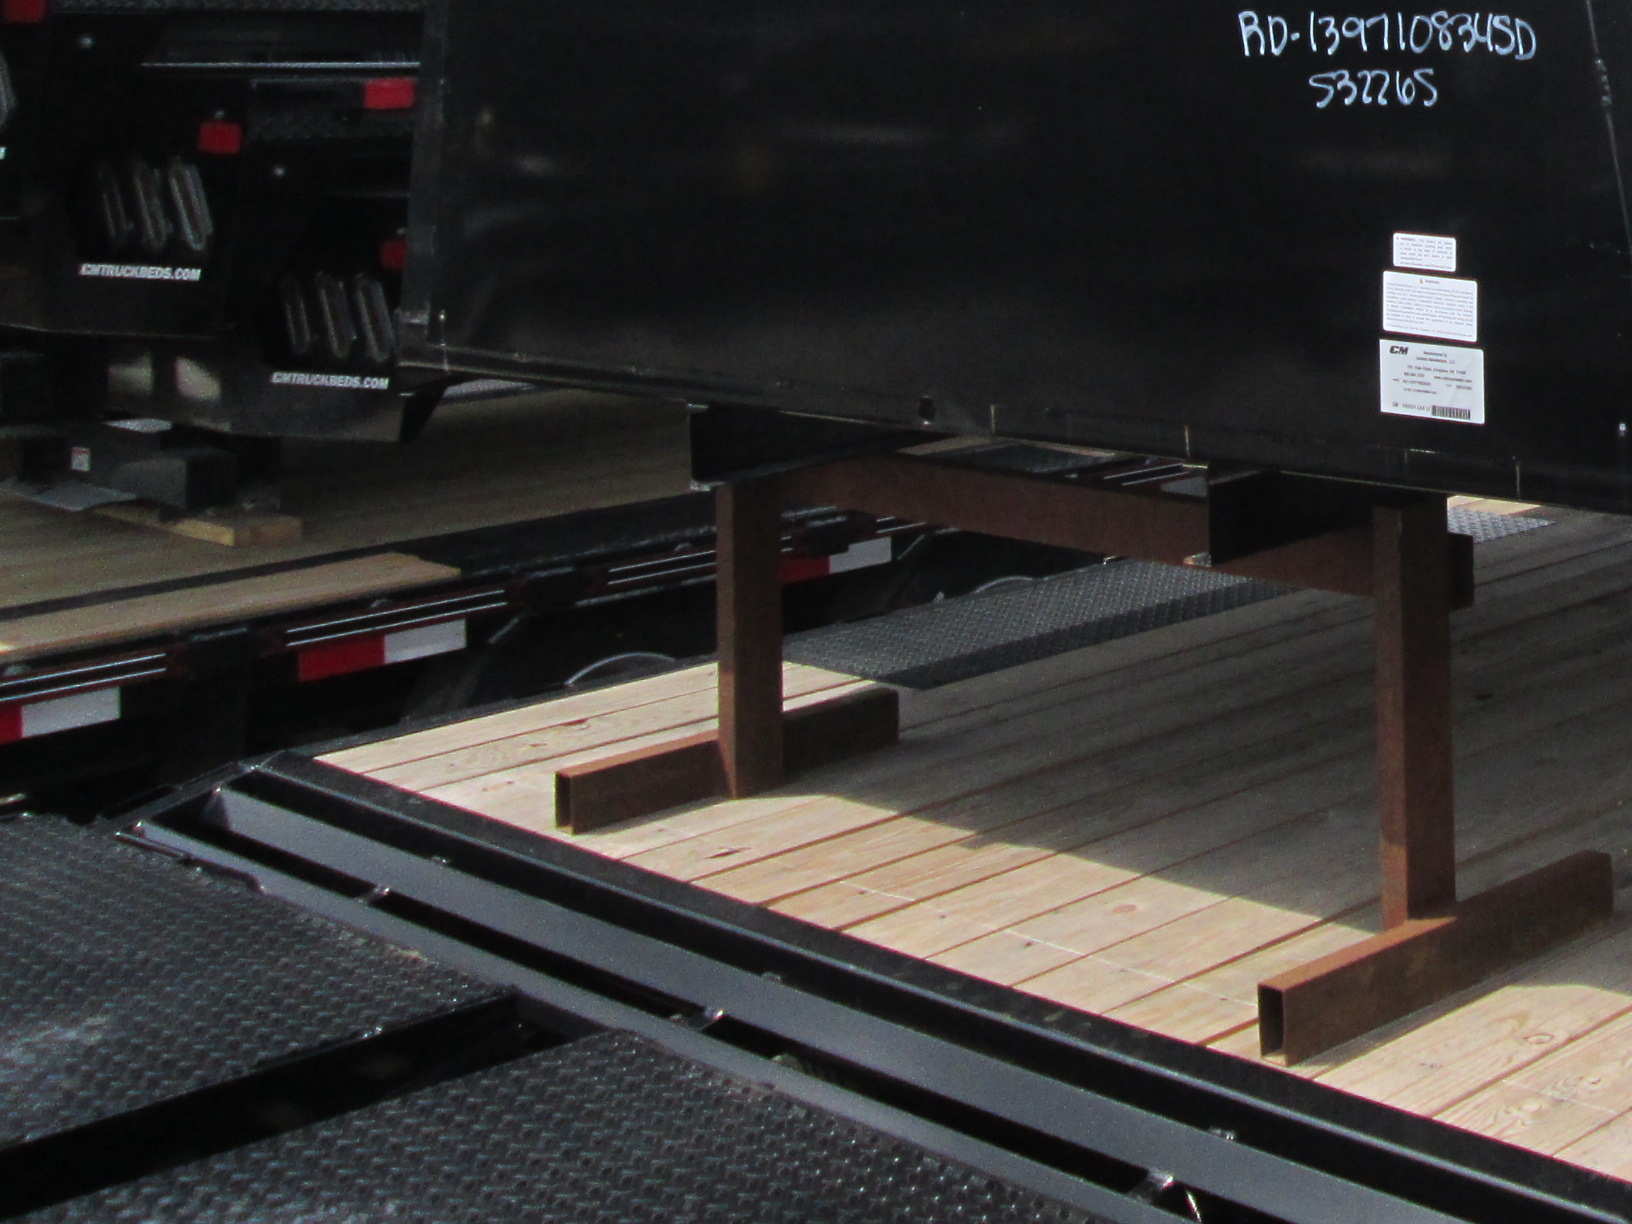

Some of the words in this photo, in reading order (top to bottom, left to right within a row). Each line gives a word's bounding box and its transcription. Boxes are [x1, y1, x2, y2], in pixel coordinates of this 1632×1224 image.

[80, 262, 202, 282] CMTRUCKBEDS.COM
[1389, 345, 1409, 356] CM
[271, 371, 390, 391] CMTRUCKBEDS.COM
